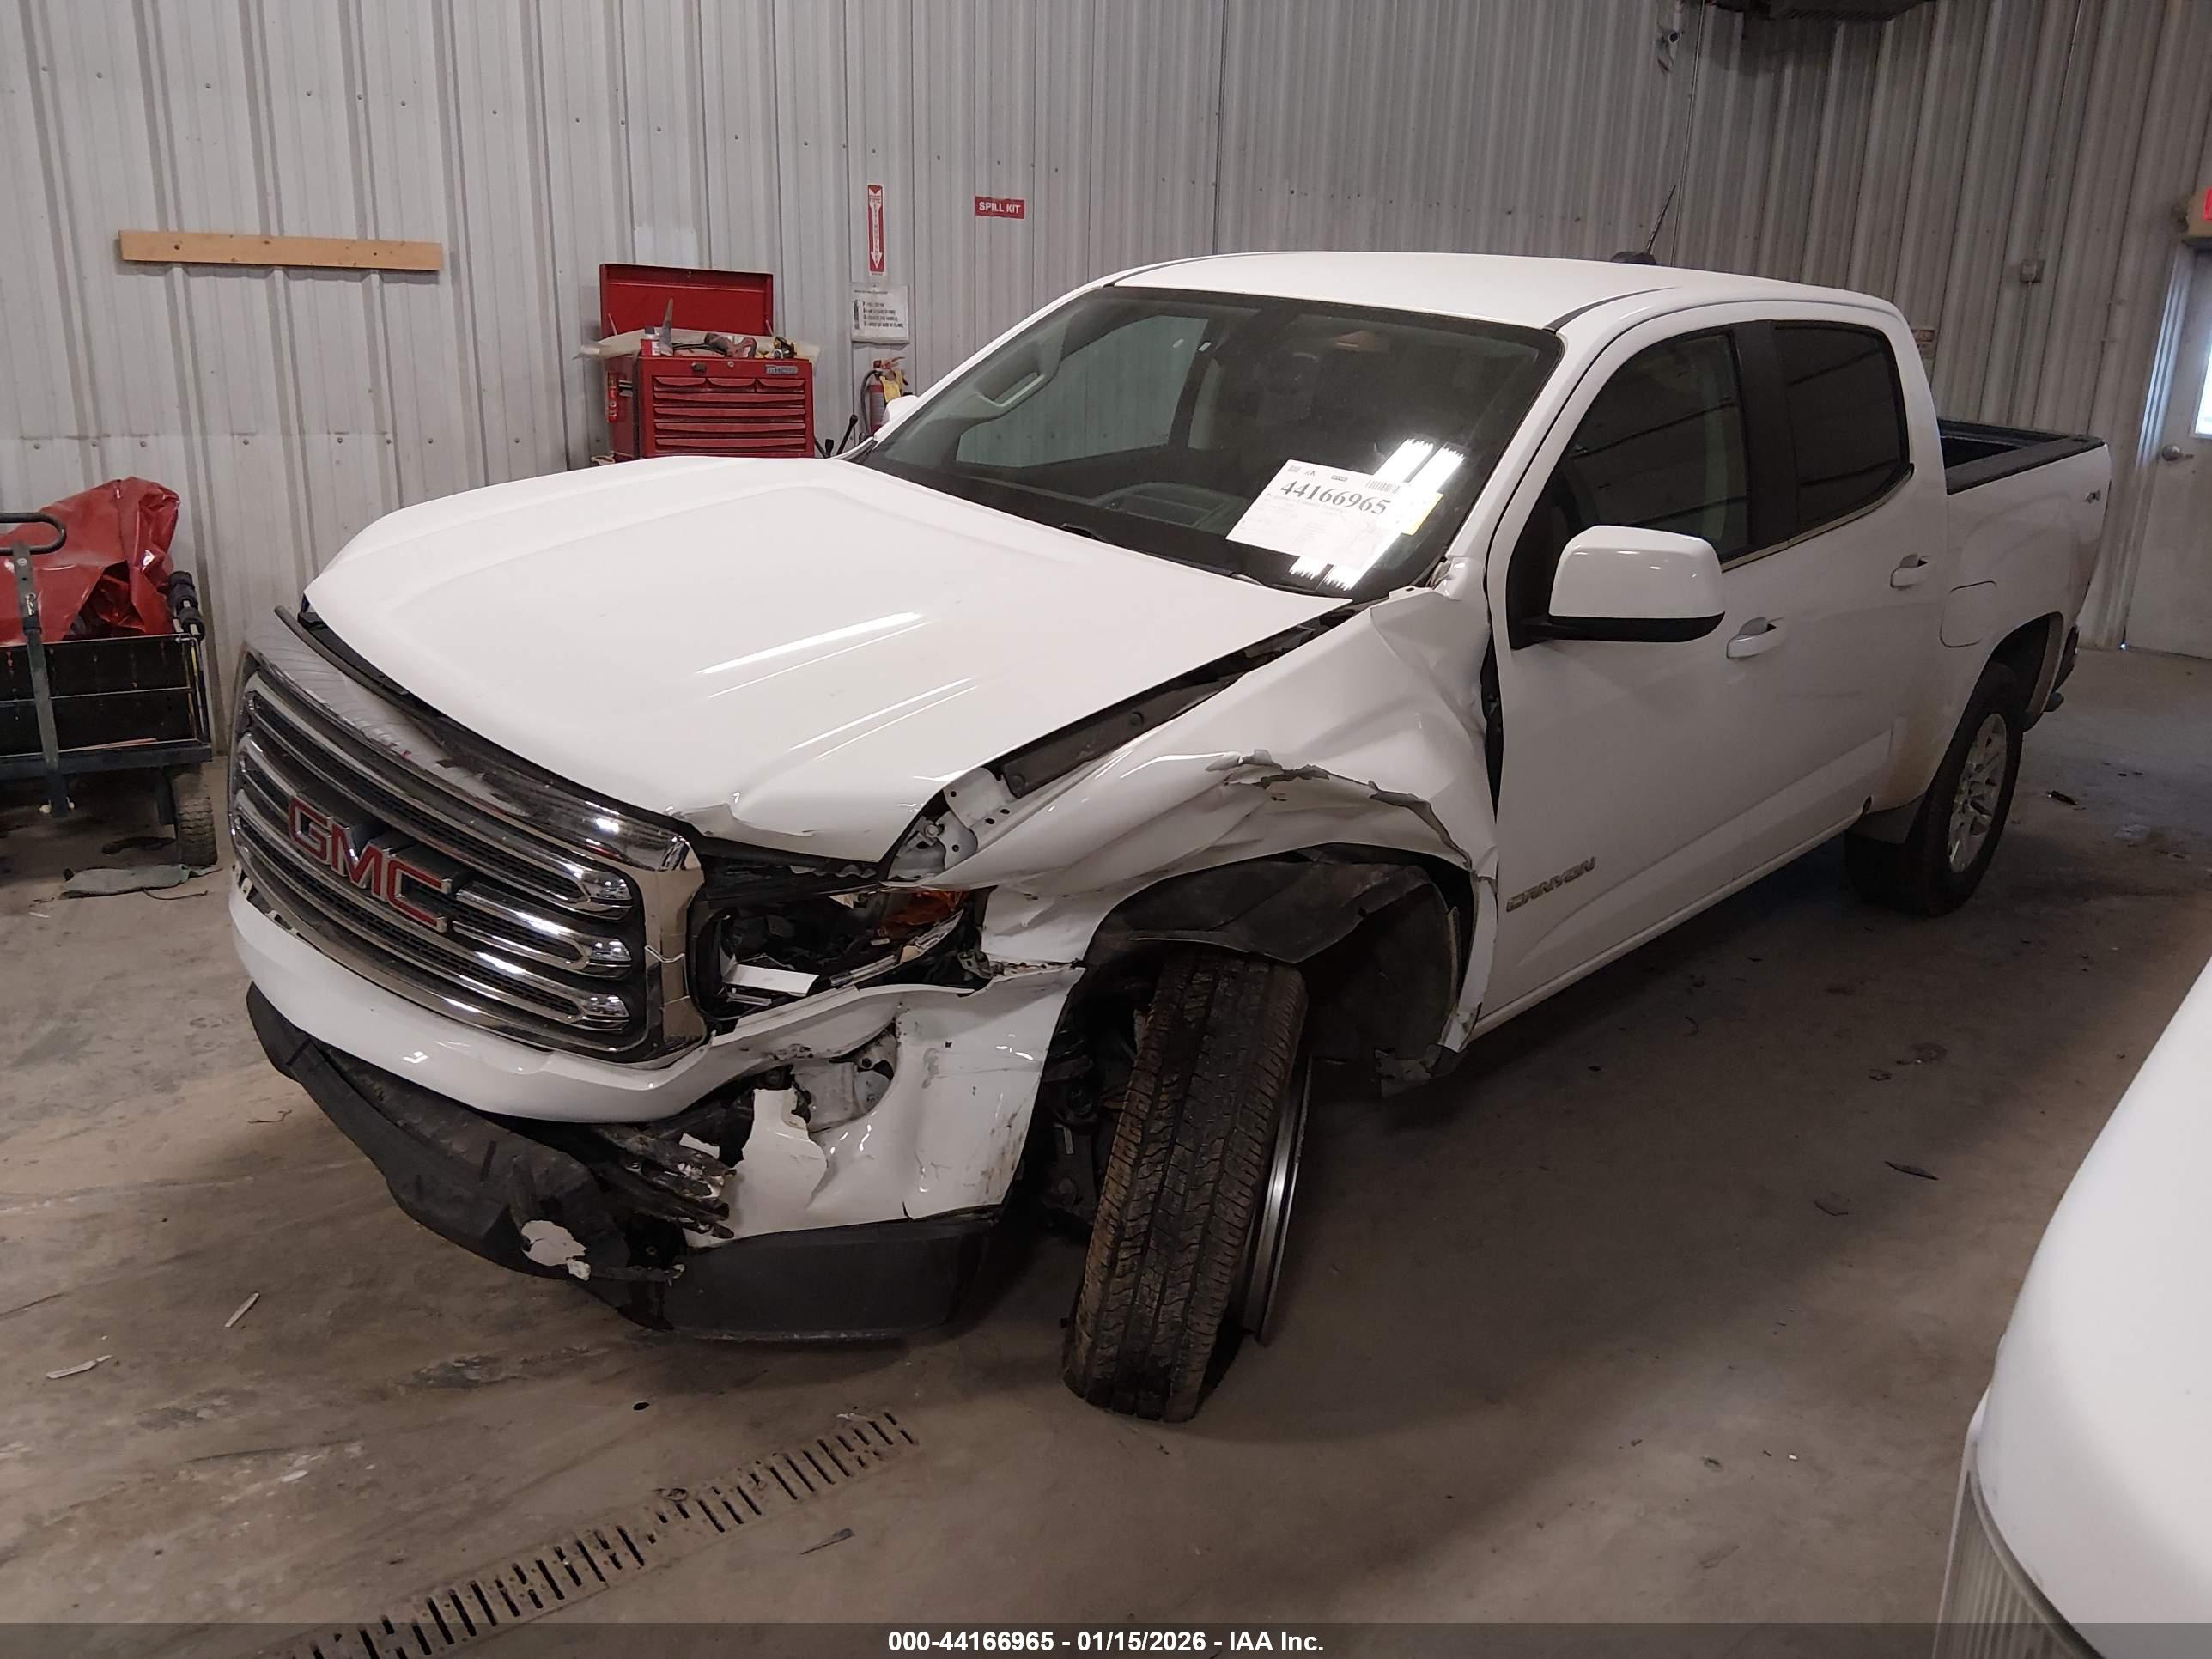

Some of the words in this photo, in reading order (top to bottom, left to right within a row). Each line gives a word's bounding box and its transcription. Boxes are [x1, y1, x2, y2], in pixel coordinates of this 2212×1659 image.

[979, 201, 1005, 213] SPILL
[1006, 204, 1021, 214] KIT
[1280, 480, 1393, 514] 44166965
[289, 795, 453, 933] GMC
